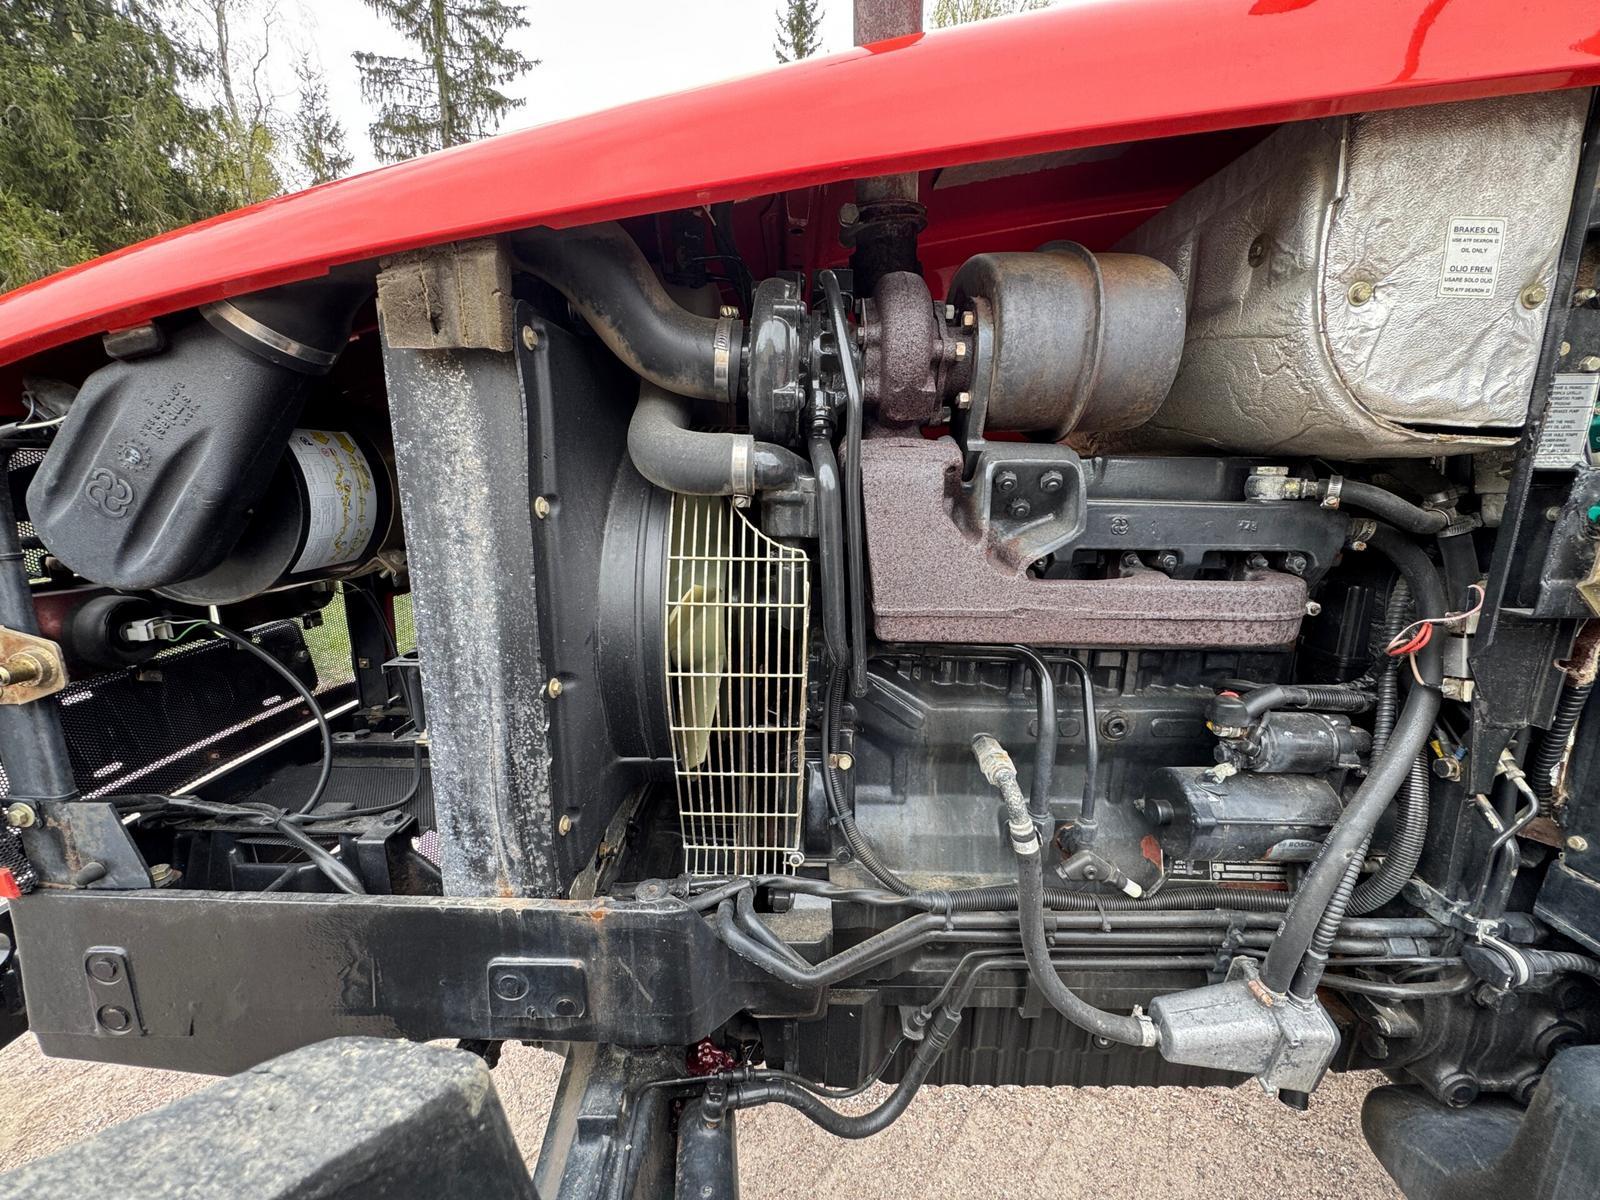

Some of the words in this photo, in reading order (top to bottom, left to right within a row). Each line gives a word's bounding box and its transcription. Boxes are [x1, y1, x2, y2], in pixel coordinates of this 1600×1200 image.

[1453, 226, 1486, 234] BRAKES
[1487, 226, 1500, 234] OIL
[1450, 265, 1469, 273] OLIO
[1470, 265, 1493, 273] FRENI
